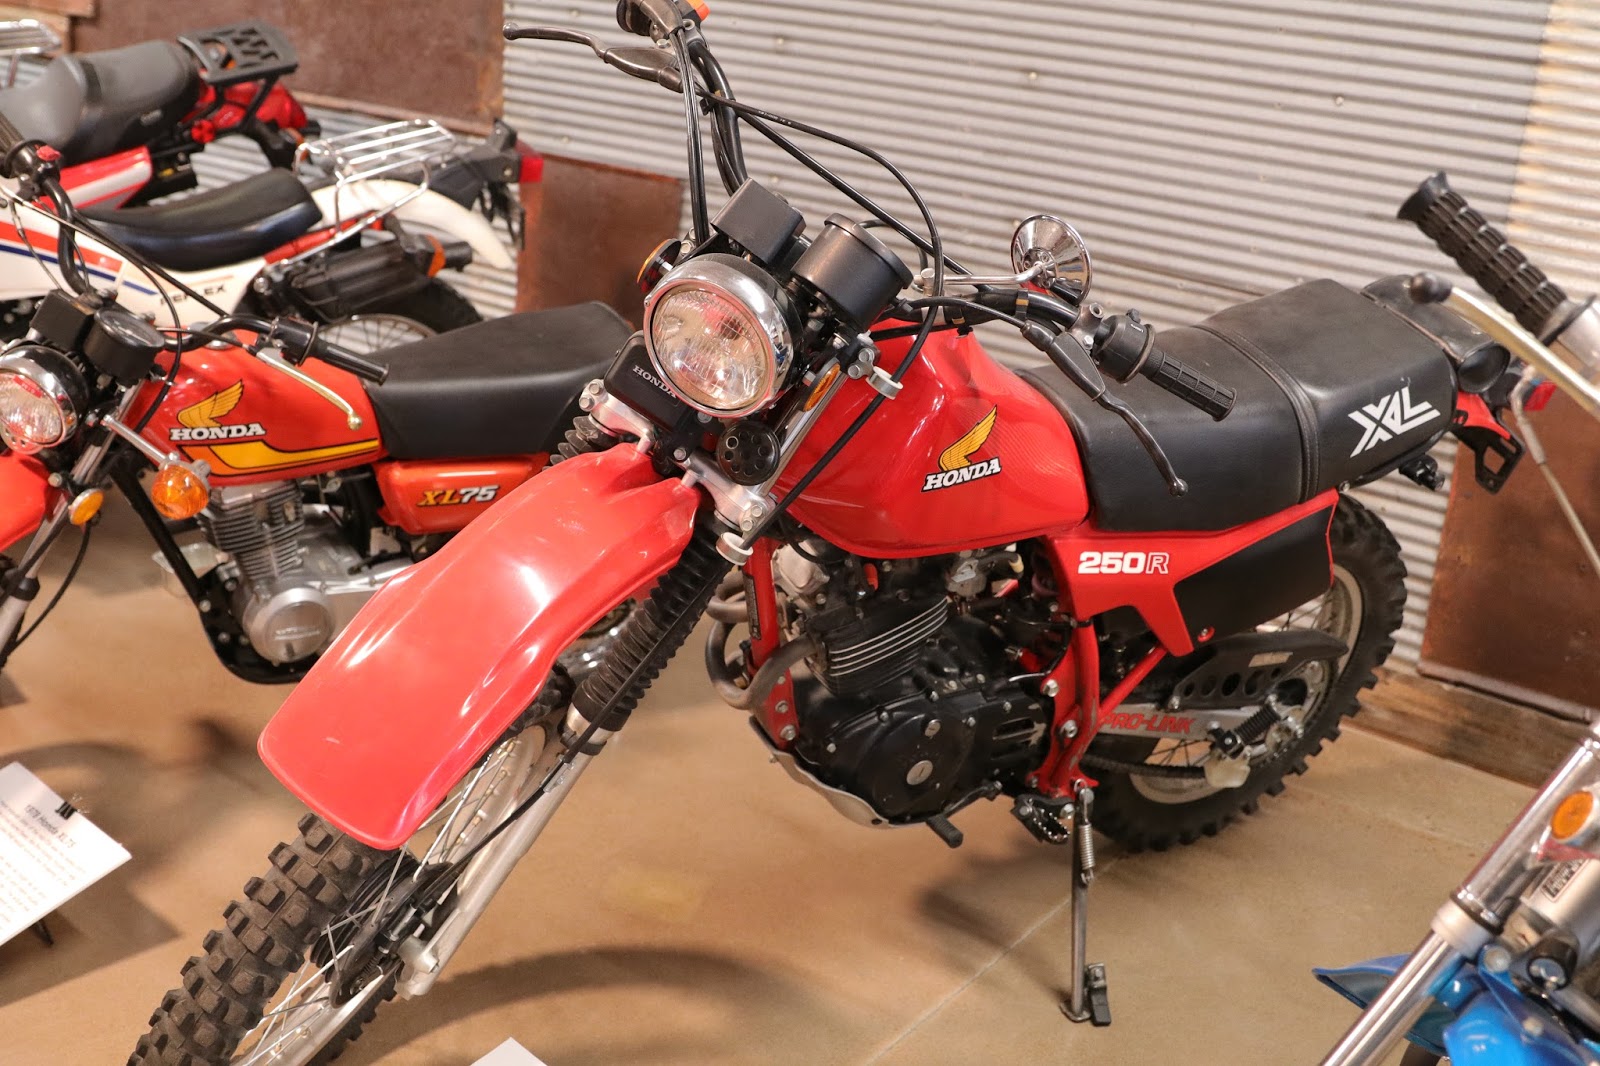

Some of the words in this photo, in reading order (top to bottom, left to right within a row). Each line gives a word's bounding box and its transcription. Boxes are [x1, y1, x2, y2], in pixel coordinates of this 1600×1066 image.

[169, 422, 267, 441] HONDA
[1347, 386, 1441, 459] XL
[922, 457, 1001, 492] HONDA
[416, 484, 500, 506] XL75
[1077, 551, 1169, 574] 250R
